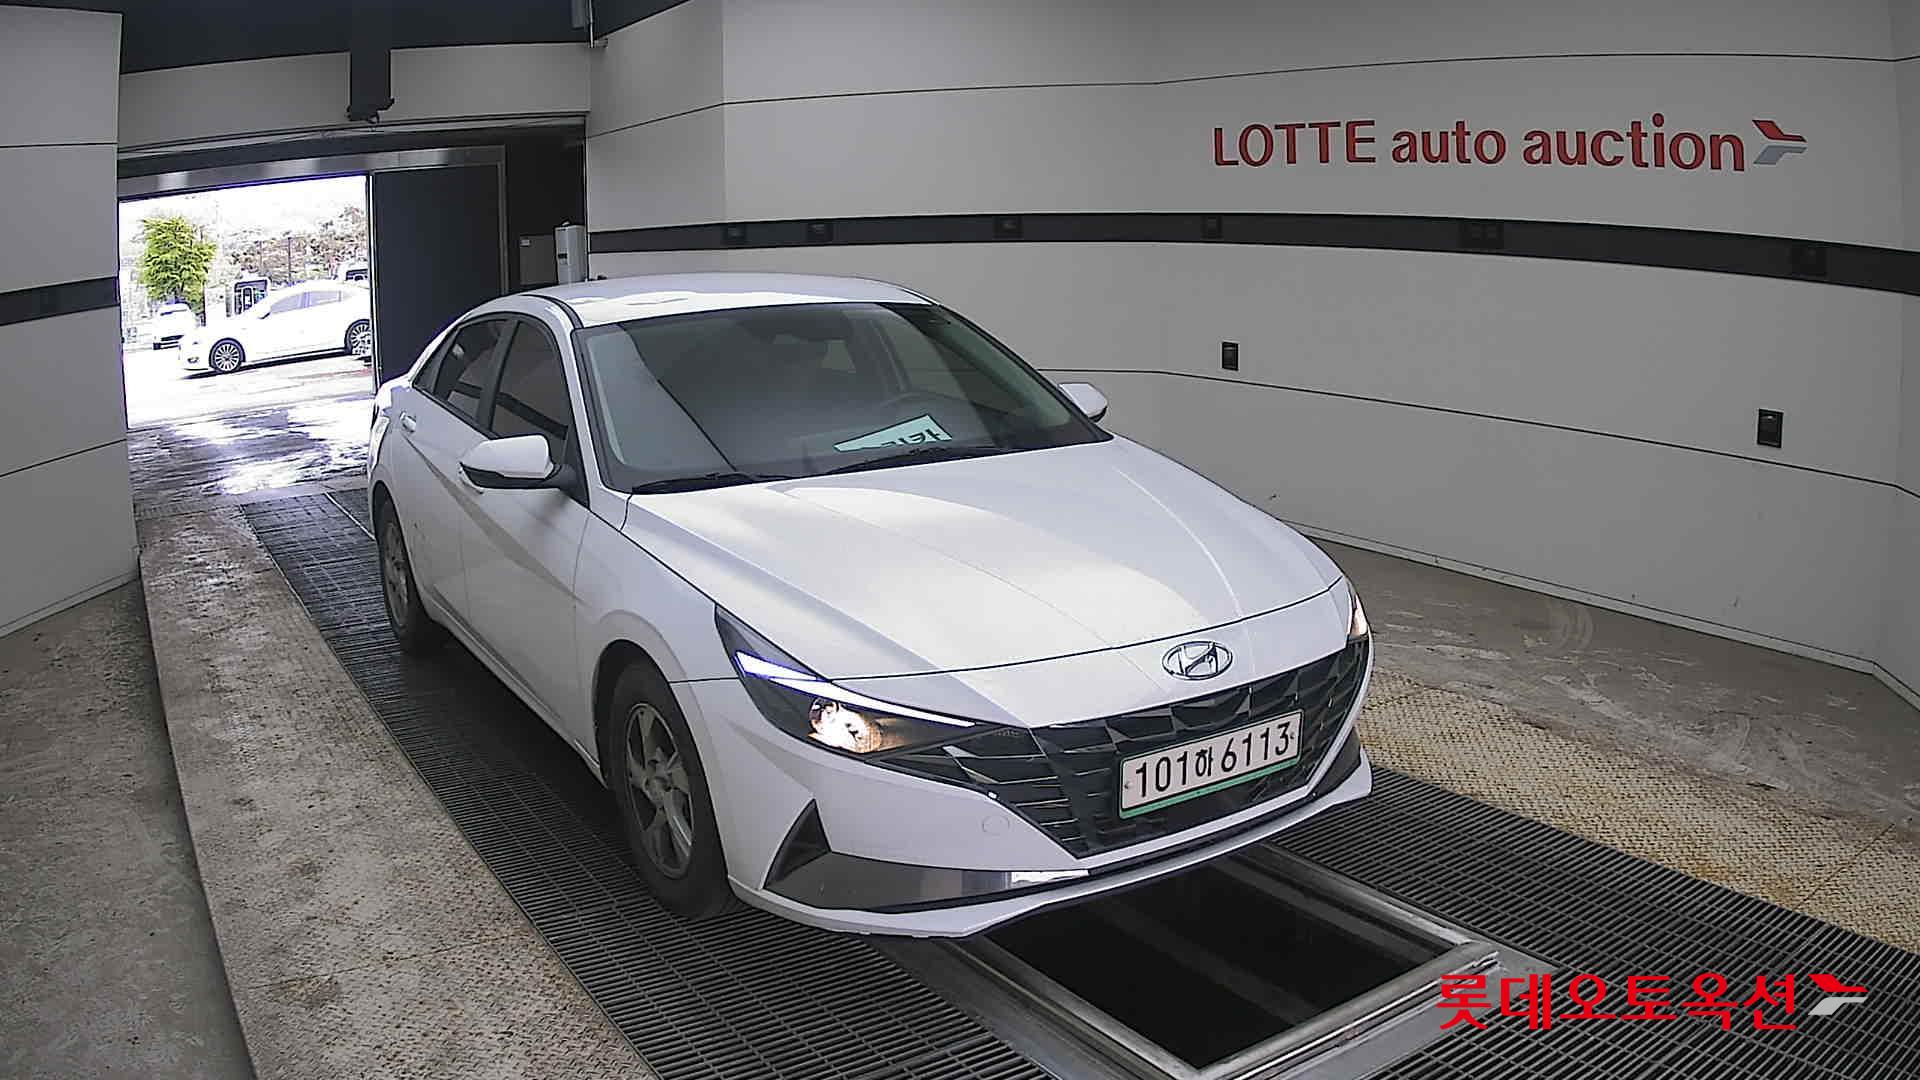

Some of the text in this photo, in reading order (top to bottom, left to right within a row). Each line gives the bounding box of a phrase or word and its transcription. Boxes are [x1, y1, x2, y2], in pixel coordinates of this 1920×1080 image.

[1213, 113, 1745, 172] LOTTE auto auction
